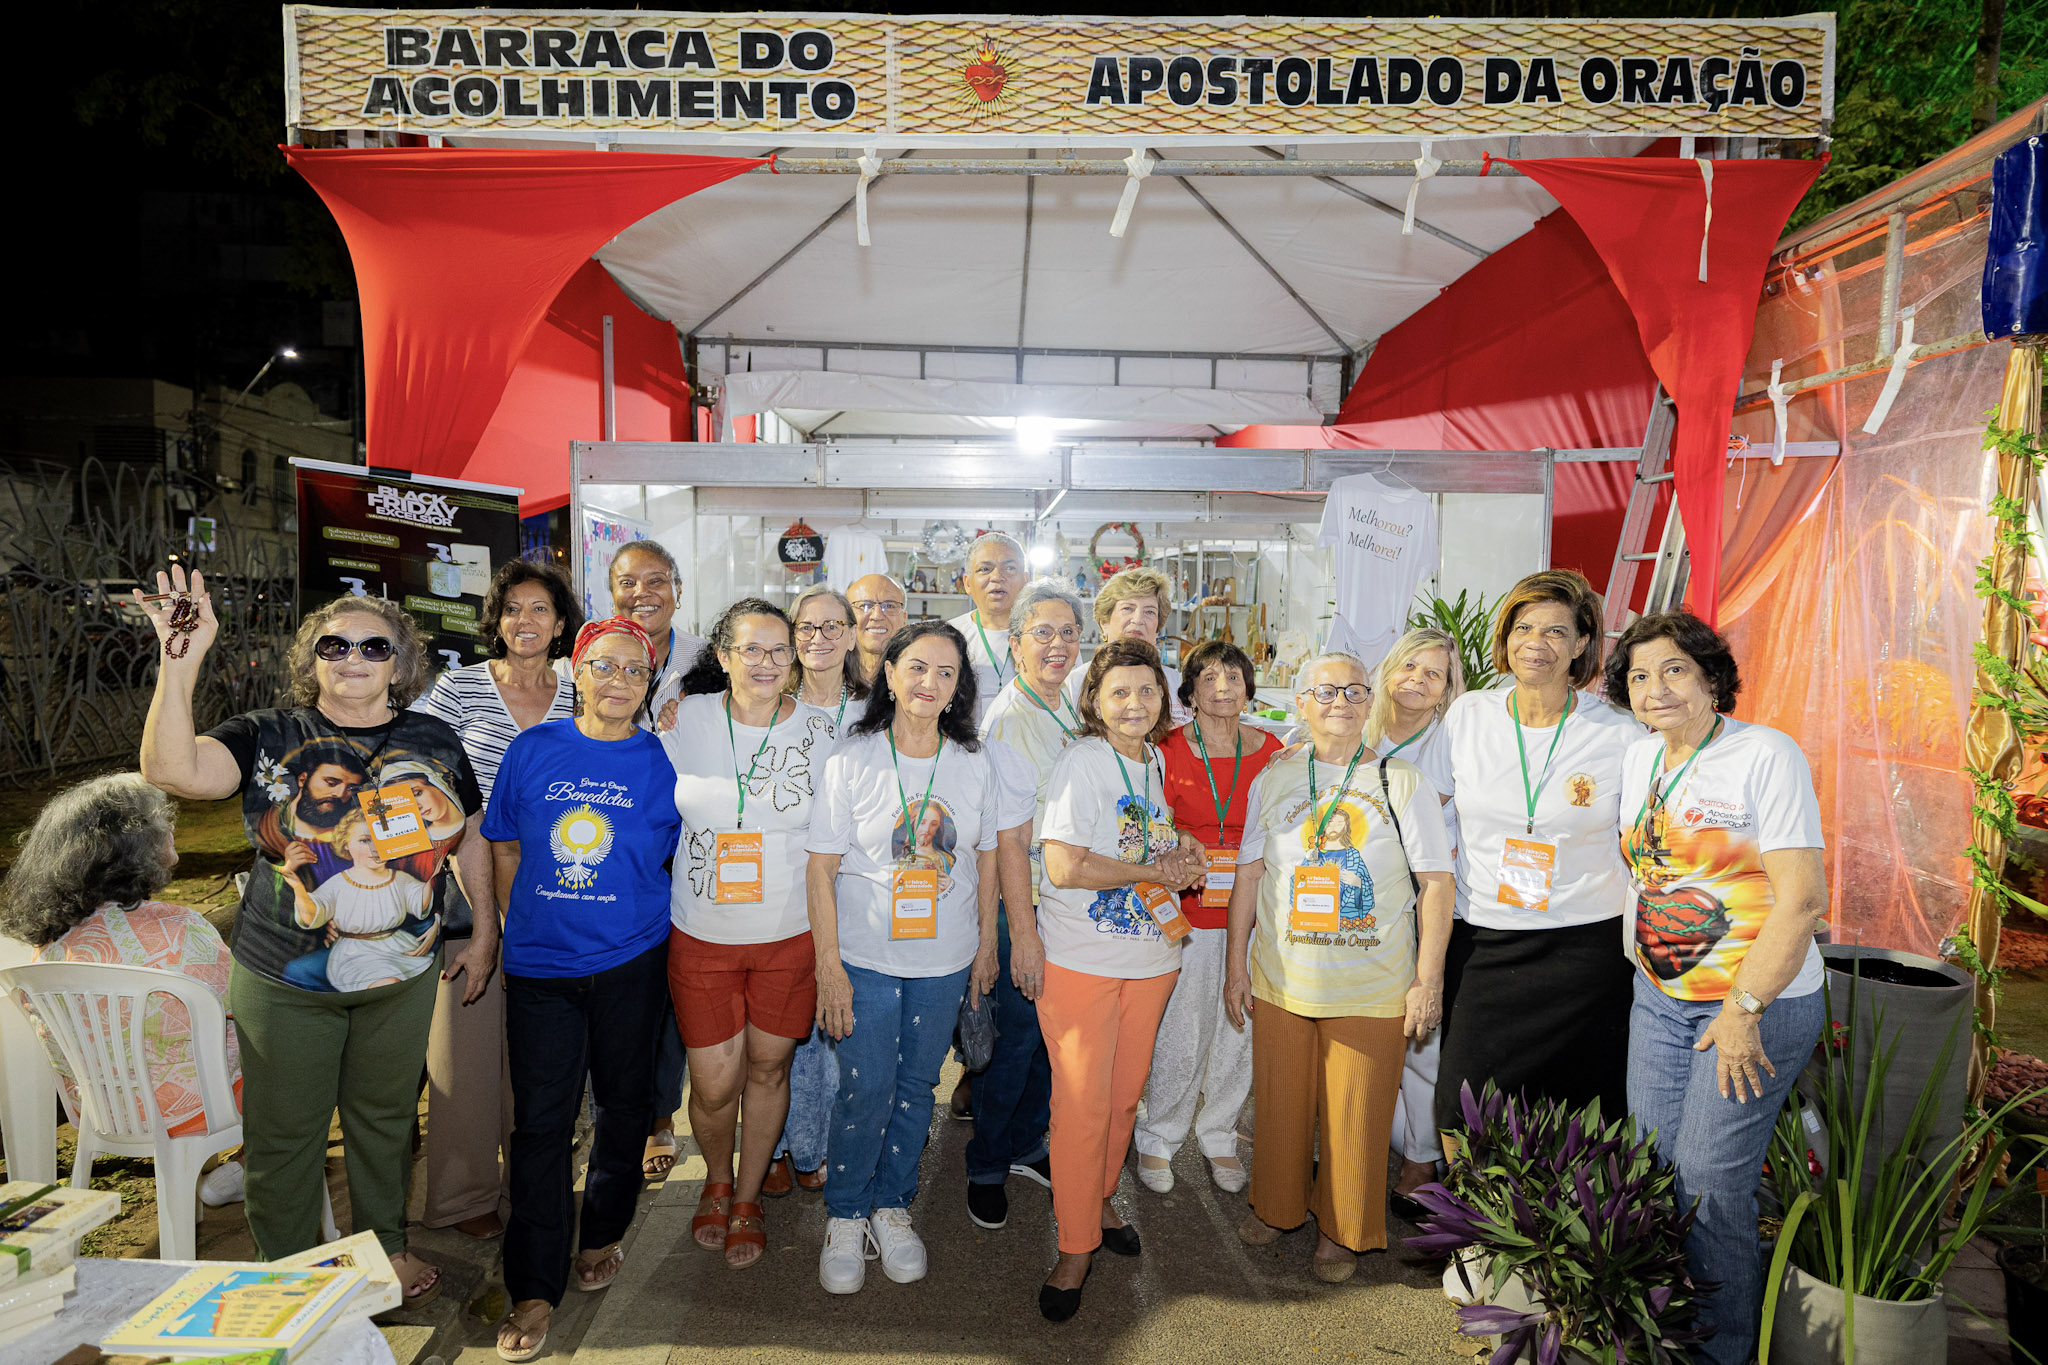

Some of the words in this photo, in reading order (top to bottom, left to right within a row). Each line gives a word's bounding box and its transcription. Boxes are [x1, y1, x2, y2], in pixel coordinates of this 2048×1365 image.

[386, 26, 717, 70] BARRACA
[737, 29, 834, 71] DO
[1086, 56, 1464, 107] APOSTOLADO
[1483, 57, 1562, 105] DA
[1579, 45, 1806, 114] ORAÇÃO
[363, 77, 857, 121] ACOLHIMENTO
[368, 493, 459, 519] FRIDAY
[378, 485, 448, 507] BLACK
[376, 506, 452, 526] EXCELSIOR
[1348, 506, 1413, 537] Melhorou?
[328, 528, 360, 536] Sabonete
[1347, 531, 1402, 560] Melhorei!
[410, 597, 439, 606] Sabonete
[545, 781, 635, 808] Benedictus
[915, 792, 956, 816] Fraernidade
[1698, 798, 1737, 811] Barraca
[1704, 817, 1718, 825] da
[1141, 922, 1162, 942] Naz
[1285, 930, 1332, 946] Apostolado
[1333, 934, 1346, 946] da
